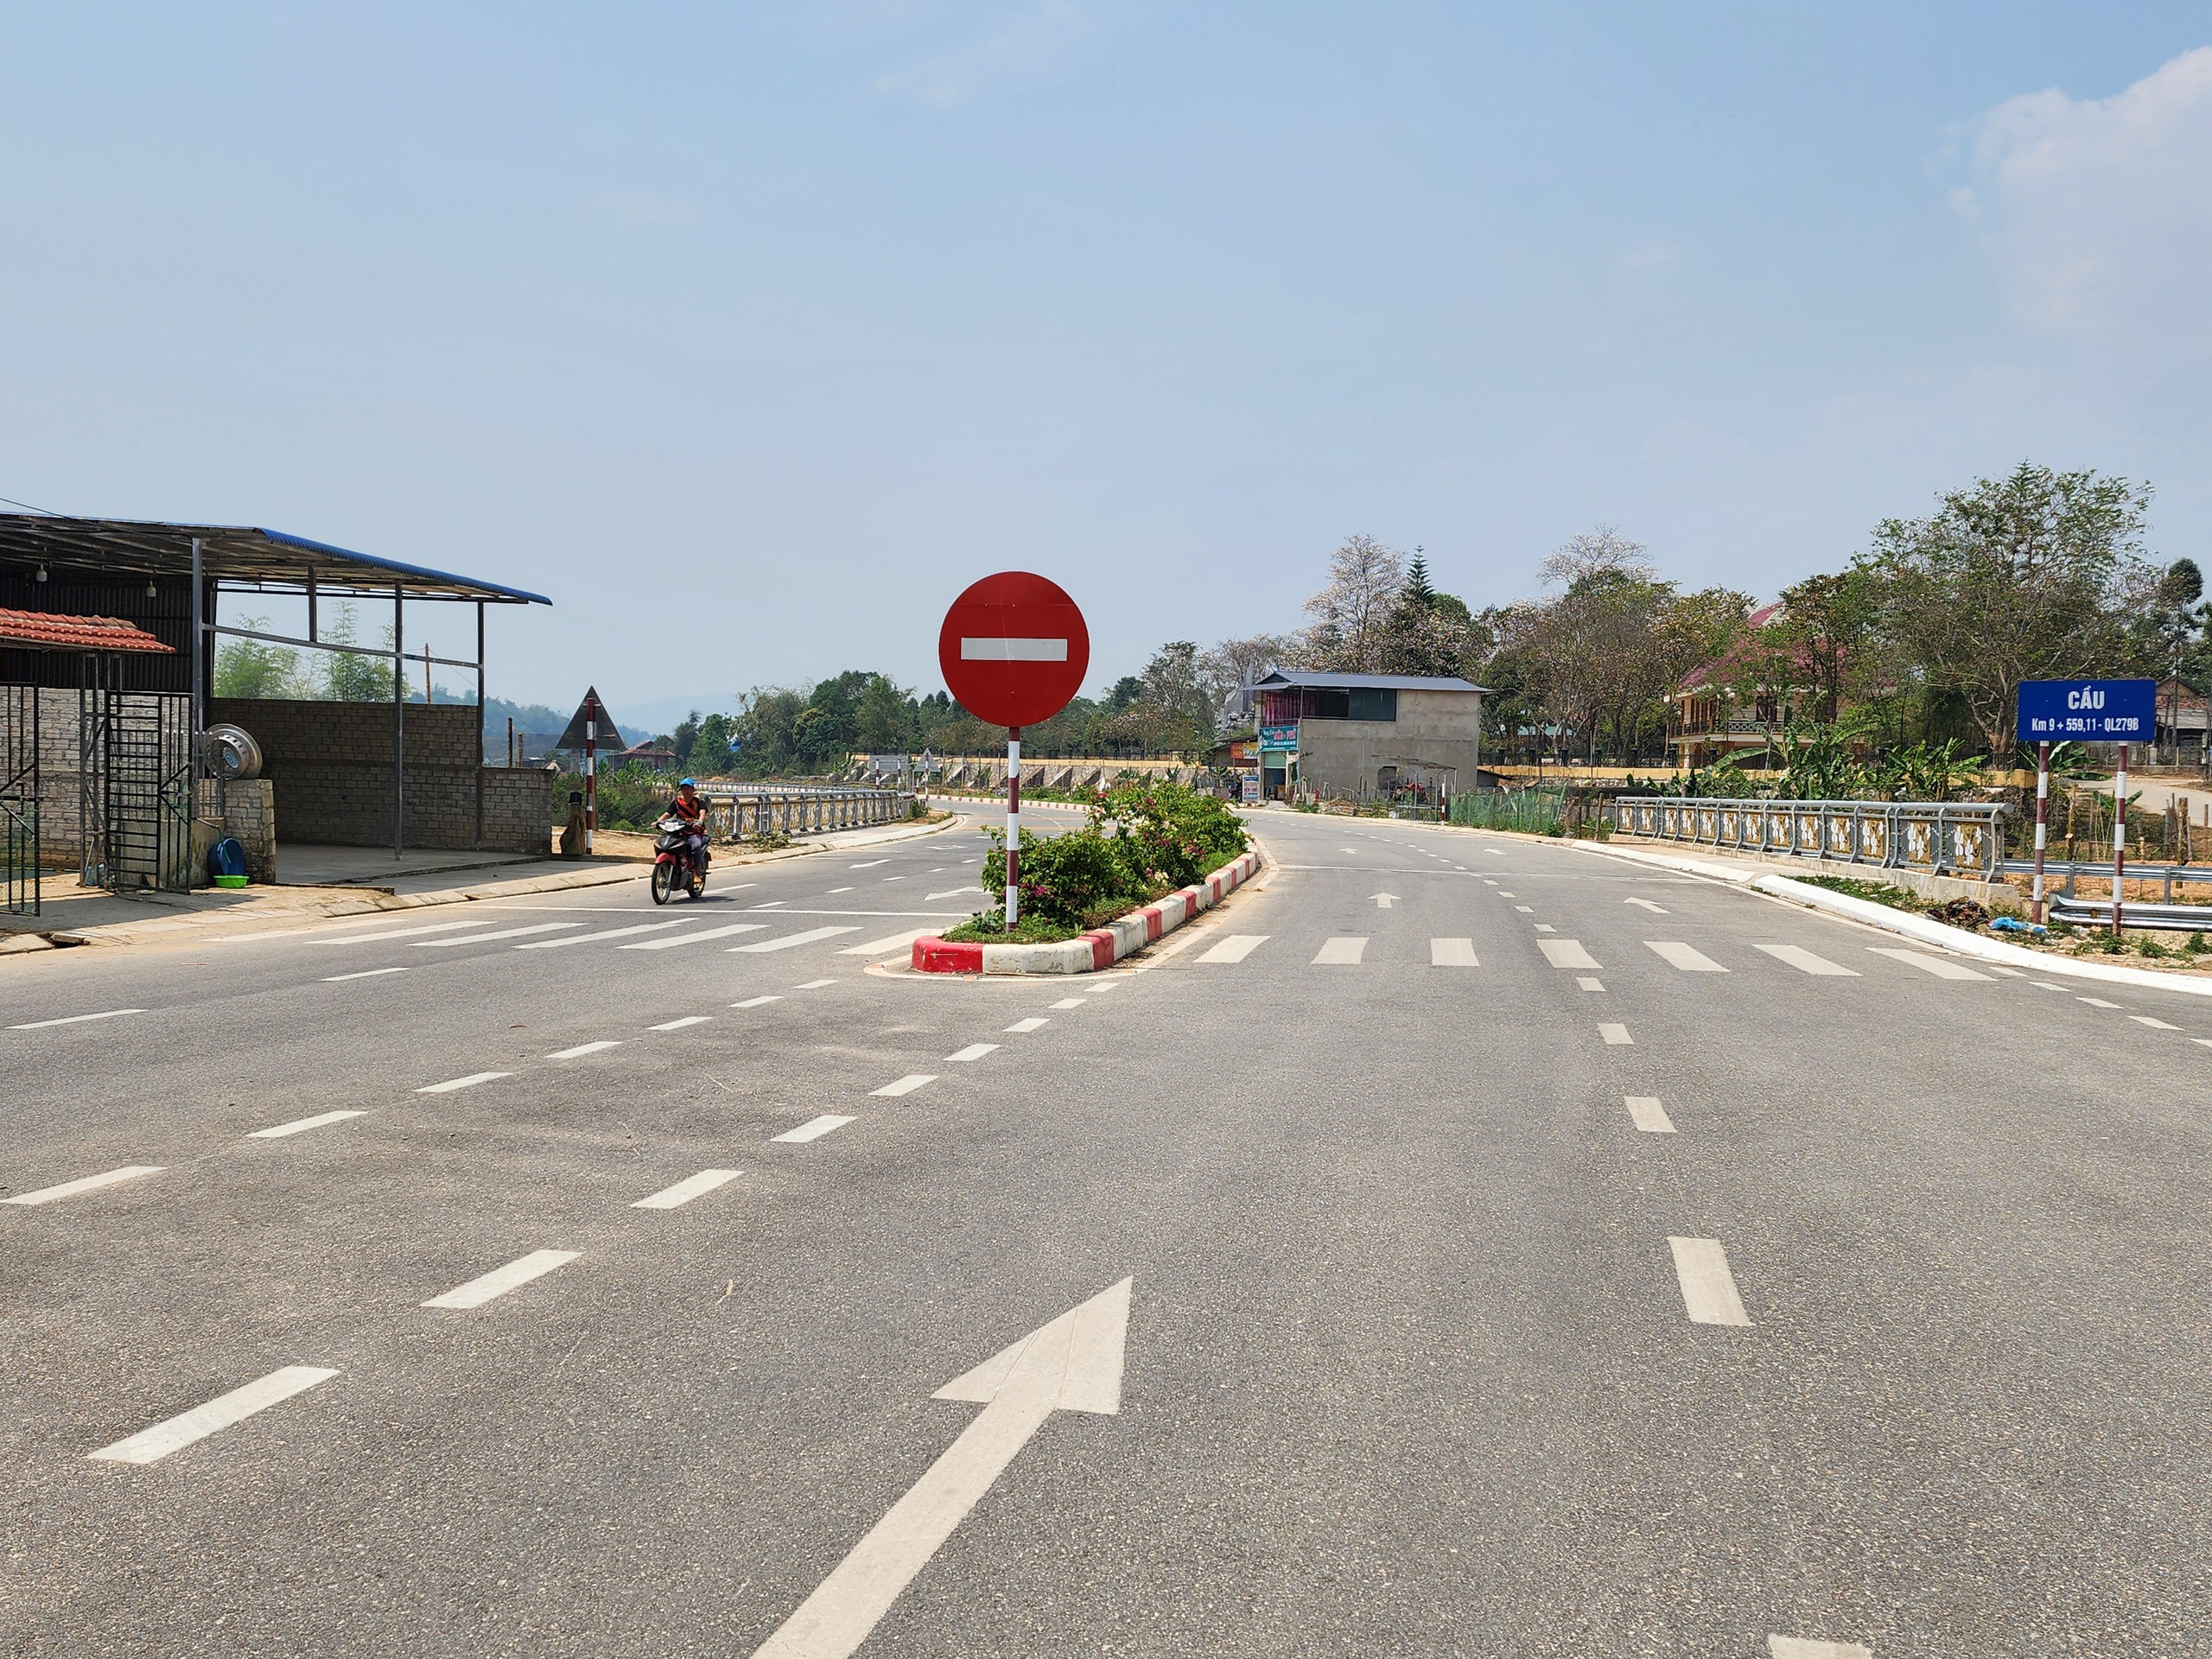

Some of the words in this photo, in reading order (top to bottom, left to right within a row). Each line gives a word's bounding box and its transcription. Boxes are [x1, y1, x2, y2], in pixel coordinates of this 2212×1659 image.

[2068, 684, 2105, 709] CẦU
[2031, 717, 2047, 732] Km
[2049, 717, 2055, 731] 9
[2057, 721, 2064, 730] +
[2105, 717, 2139, 732] QL279B
